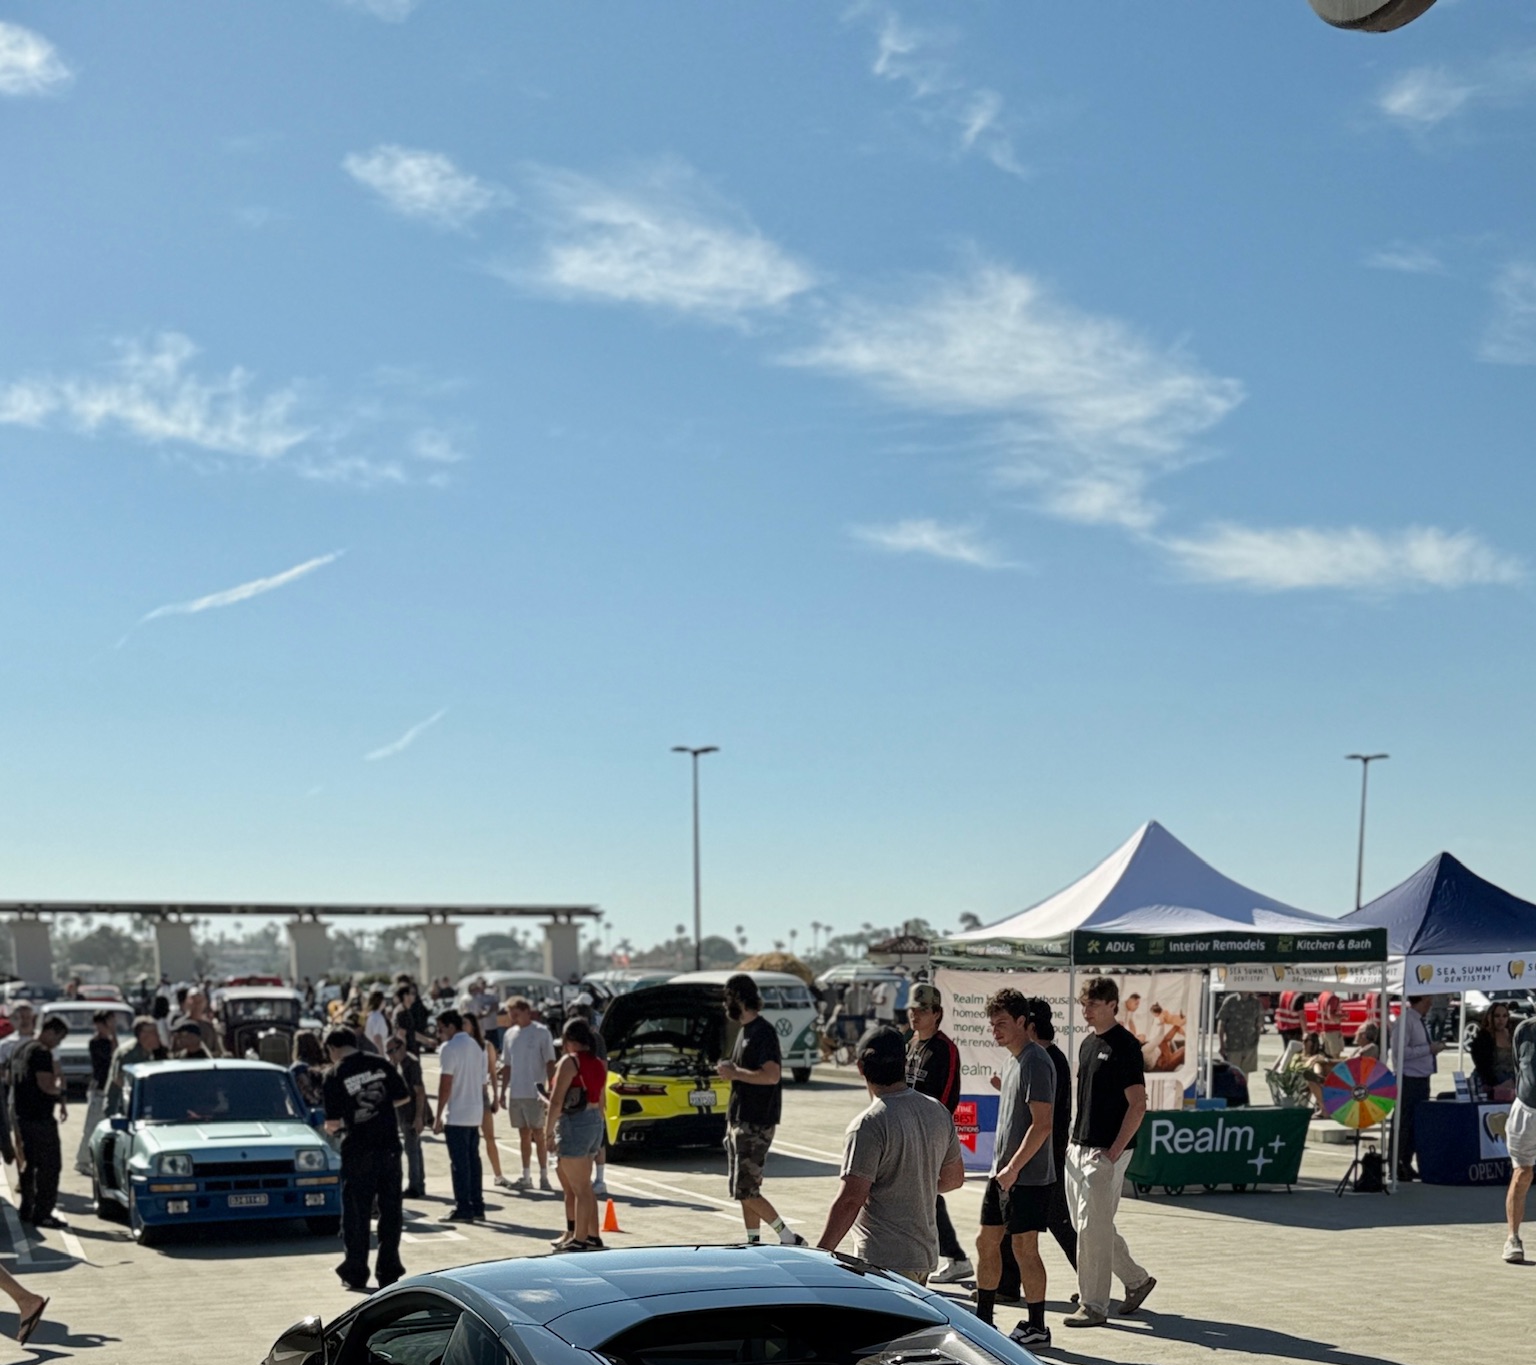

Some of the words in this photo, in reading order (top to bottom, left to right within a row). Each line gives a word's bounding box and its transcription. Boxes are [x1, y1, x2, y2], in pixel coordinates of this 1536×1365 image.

[1105, 941, 1135, 952] ADUs
[1169, 940, 1210, 952] Interior
[1212, 938, 1265, 952] Remodels
[1296, 939, 1335, 950] Kitchen
[1337, 939, 1345, 950] &
[1347, 938, 1371, 950] Bath
[1437, 966, 1456, 976] SEA
[1462, 964, 1502, 974] SUMMIT
[1444, 974, 1492, 983] DENTISTRY
[953, 993, 984, 1004] Realm
[953, 1023, 985, 1035] money
[961, 1062, 992, 1076] ealm
[1151, 1117, 1255, 1155] Realm
[1468, 1161, 1504, 1181] OPEN
